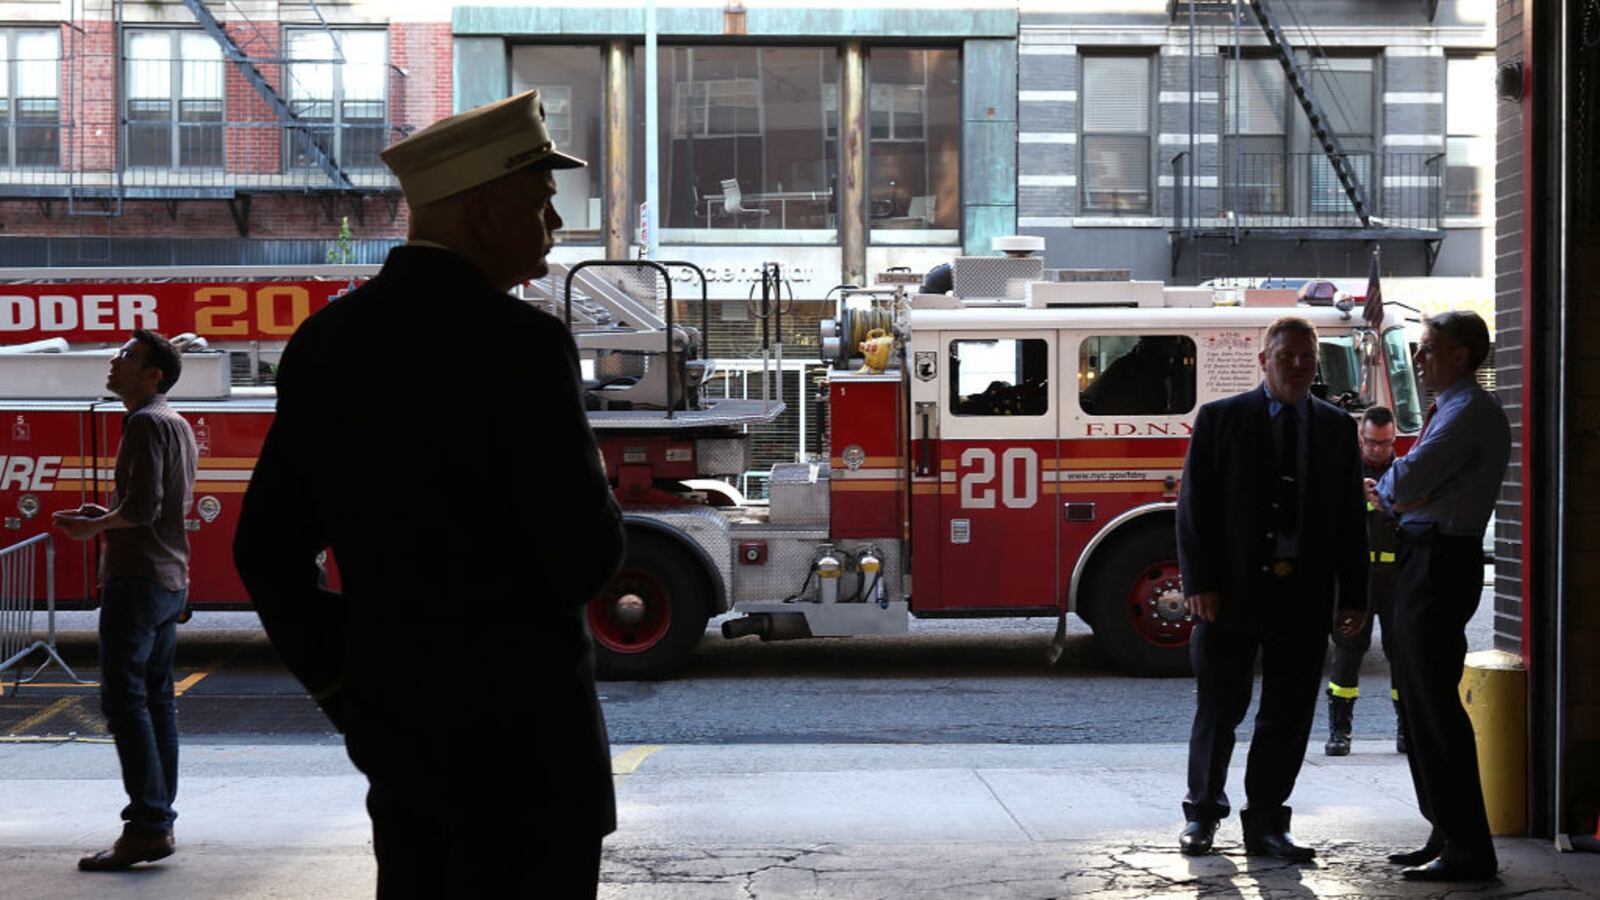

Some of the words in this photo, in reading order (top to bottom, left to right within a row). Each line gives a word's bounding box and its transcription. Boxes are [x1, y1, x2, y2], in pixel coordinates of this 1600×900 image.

[0, 294, 159, 331] DDER
[194, 286, 310, 335] 20
[17, 415, 25, 425] 5
[197, 417, 205, 427] 4
[960, 447, 1038, 509] 20
